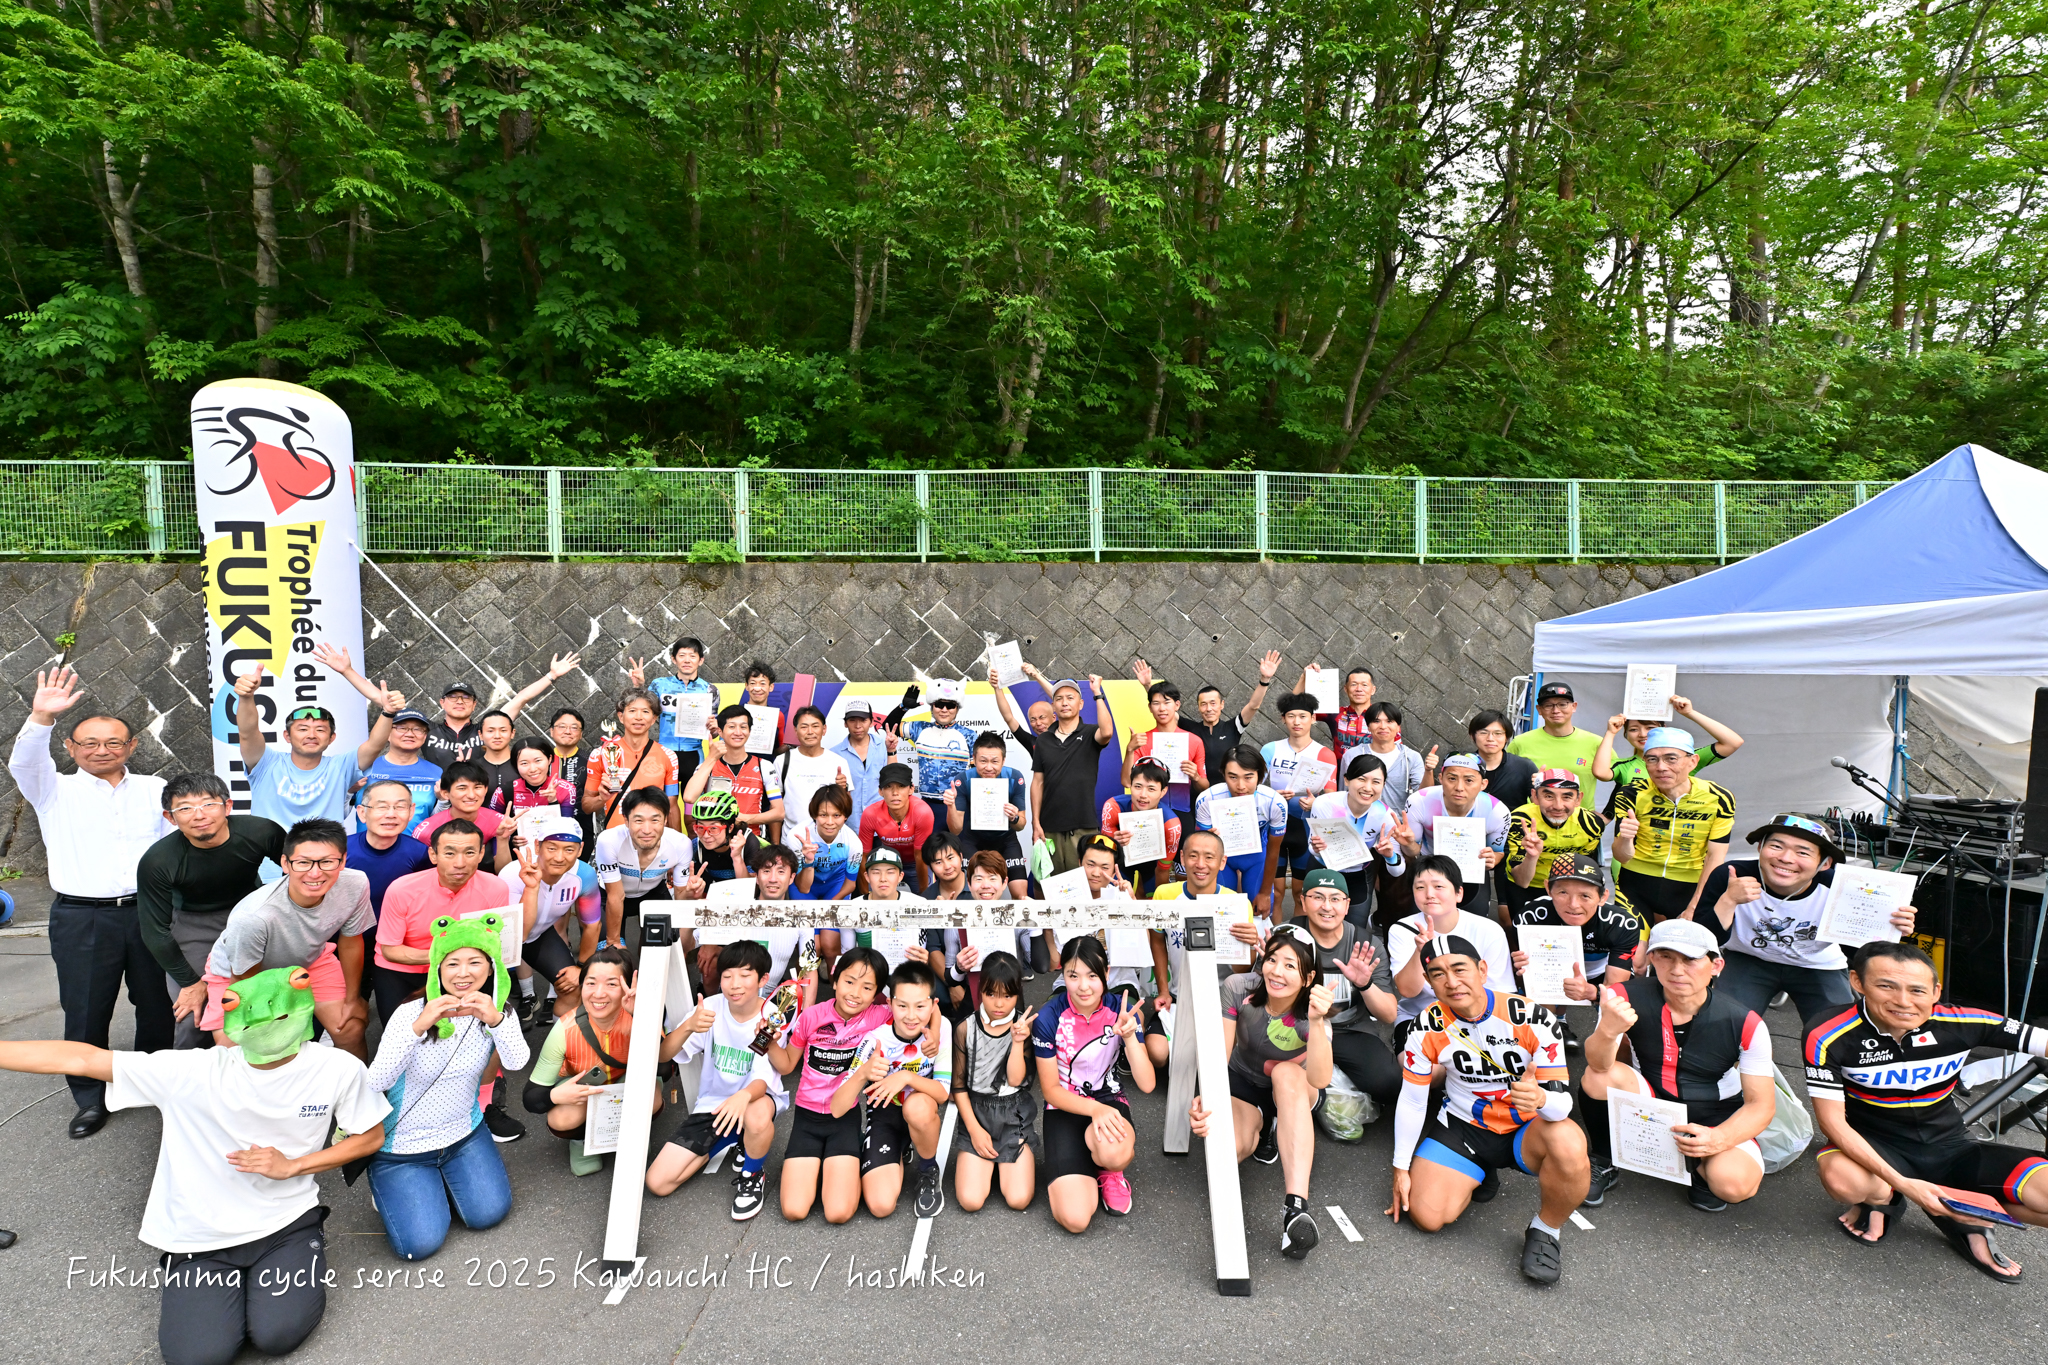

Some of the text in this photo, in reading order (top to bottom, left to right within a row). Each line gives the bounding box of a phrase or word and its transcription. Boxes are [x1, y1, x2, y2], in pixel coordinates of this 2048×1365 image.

[279, 525, 326, 702] Trophée du
[214, 521, 278, 811] FUKUSH
[1064, 1016, 1076, 1045] Tour
[1859, 1049, 1890, 1059] TEAM
[1859, 1053, 1893, 1065] GINRIN
[1806, 1066, 1835, 1082] 銀輪
[1847, 1056, 1964, 1087] GINRIN
[300, 1104, 330, 1113] STAFF
